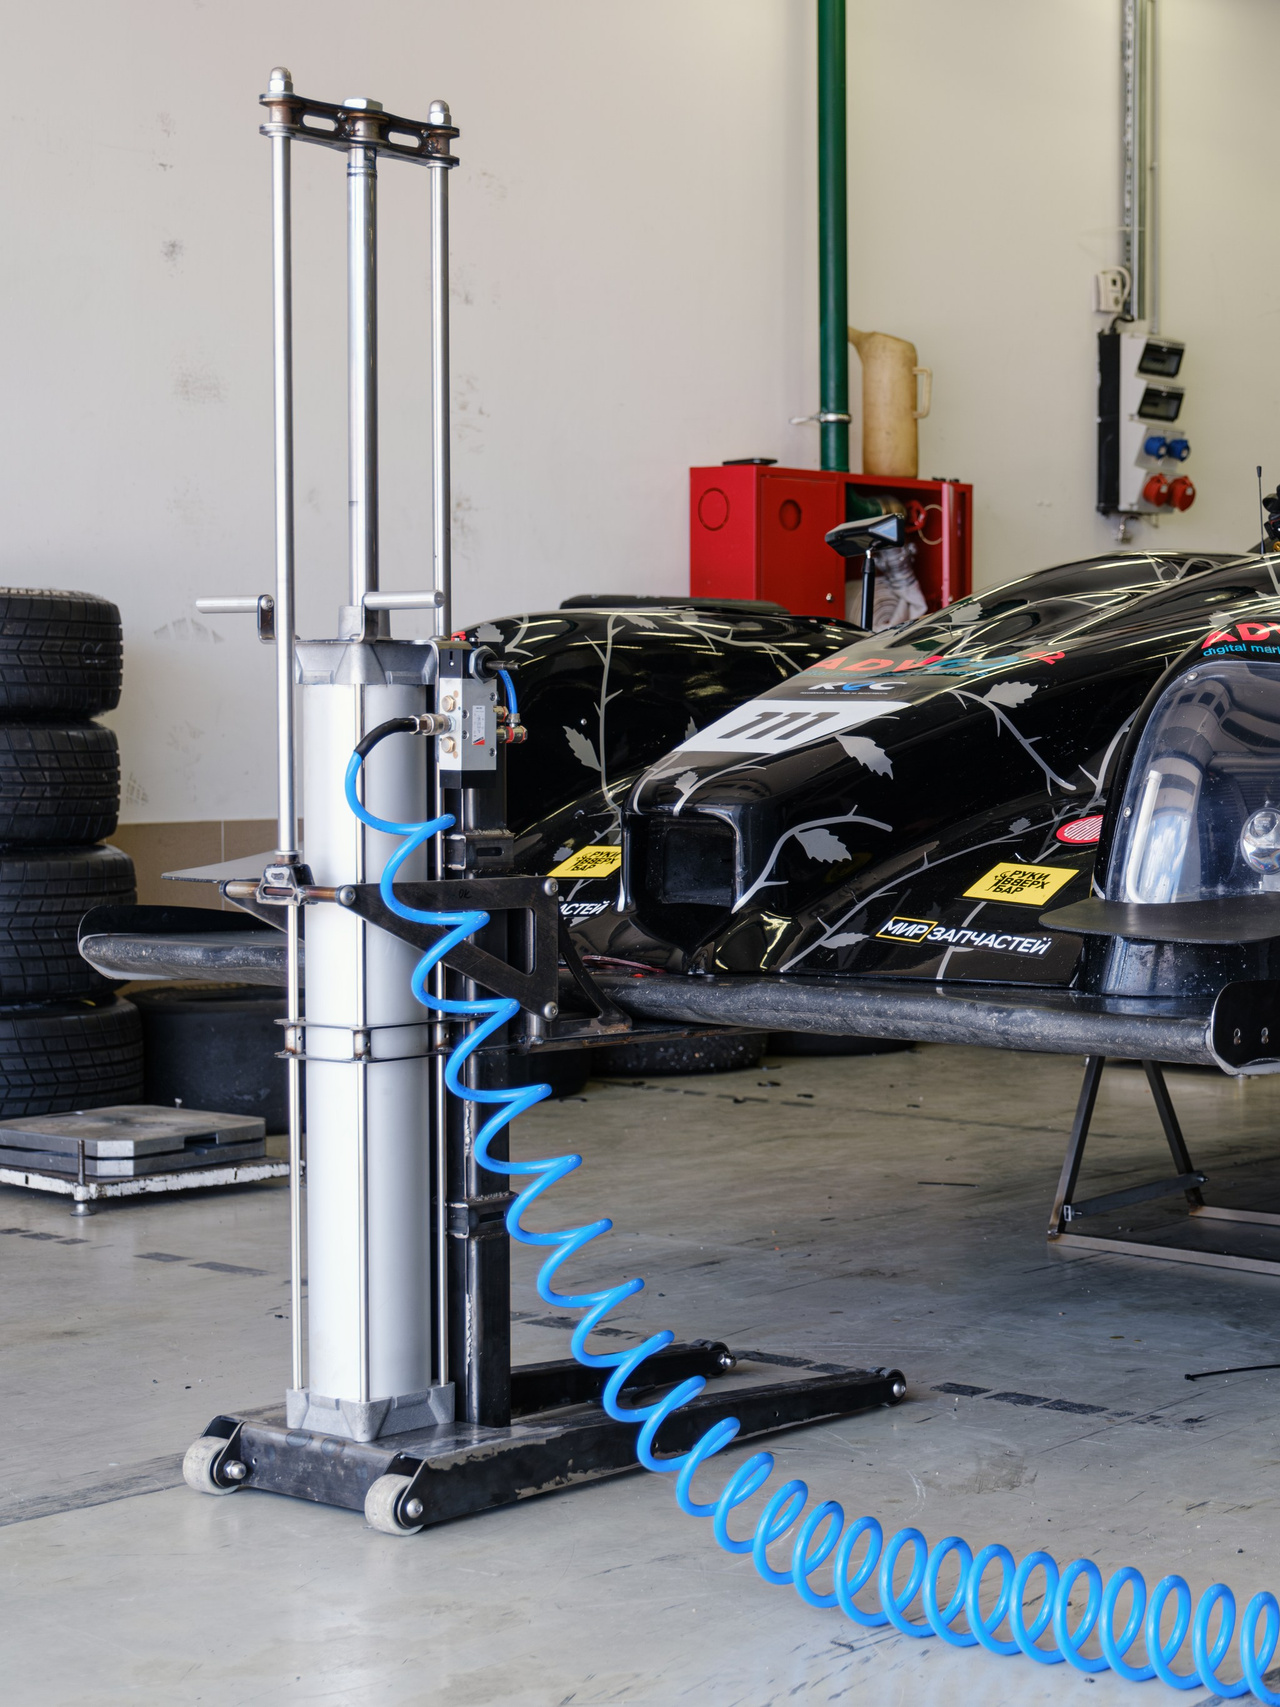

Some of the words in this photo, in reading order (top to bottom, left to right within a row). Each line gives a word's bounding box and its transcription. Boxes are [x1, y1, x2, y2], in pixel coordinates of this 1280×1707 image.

[1203, 644, 1247, 657] digital
[717, 711, 841, 740] 111
[1009, 870, 1051, 881] РУКИ
[992, 885, 1024, 894] БАР
[880, 920, 929, 938] МИР
[927, 926, 1052, 955] ЗАПЧАСТЕЙ
